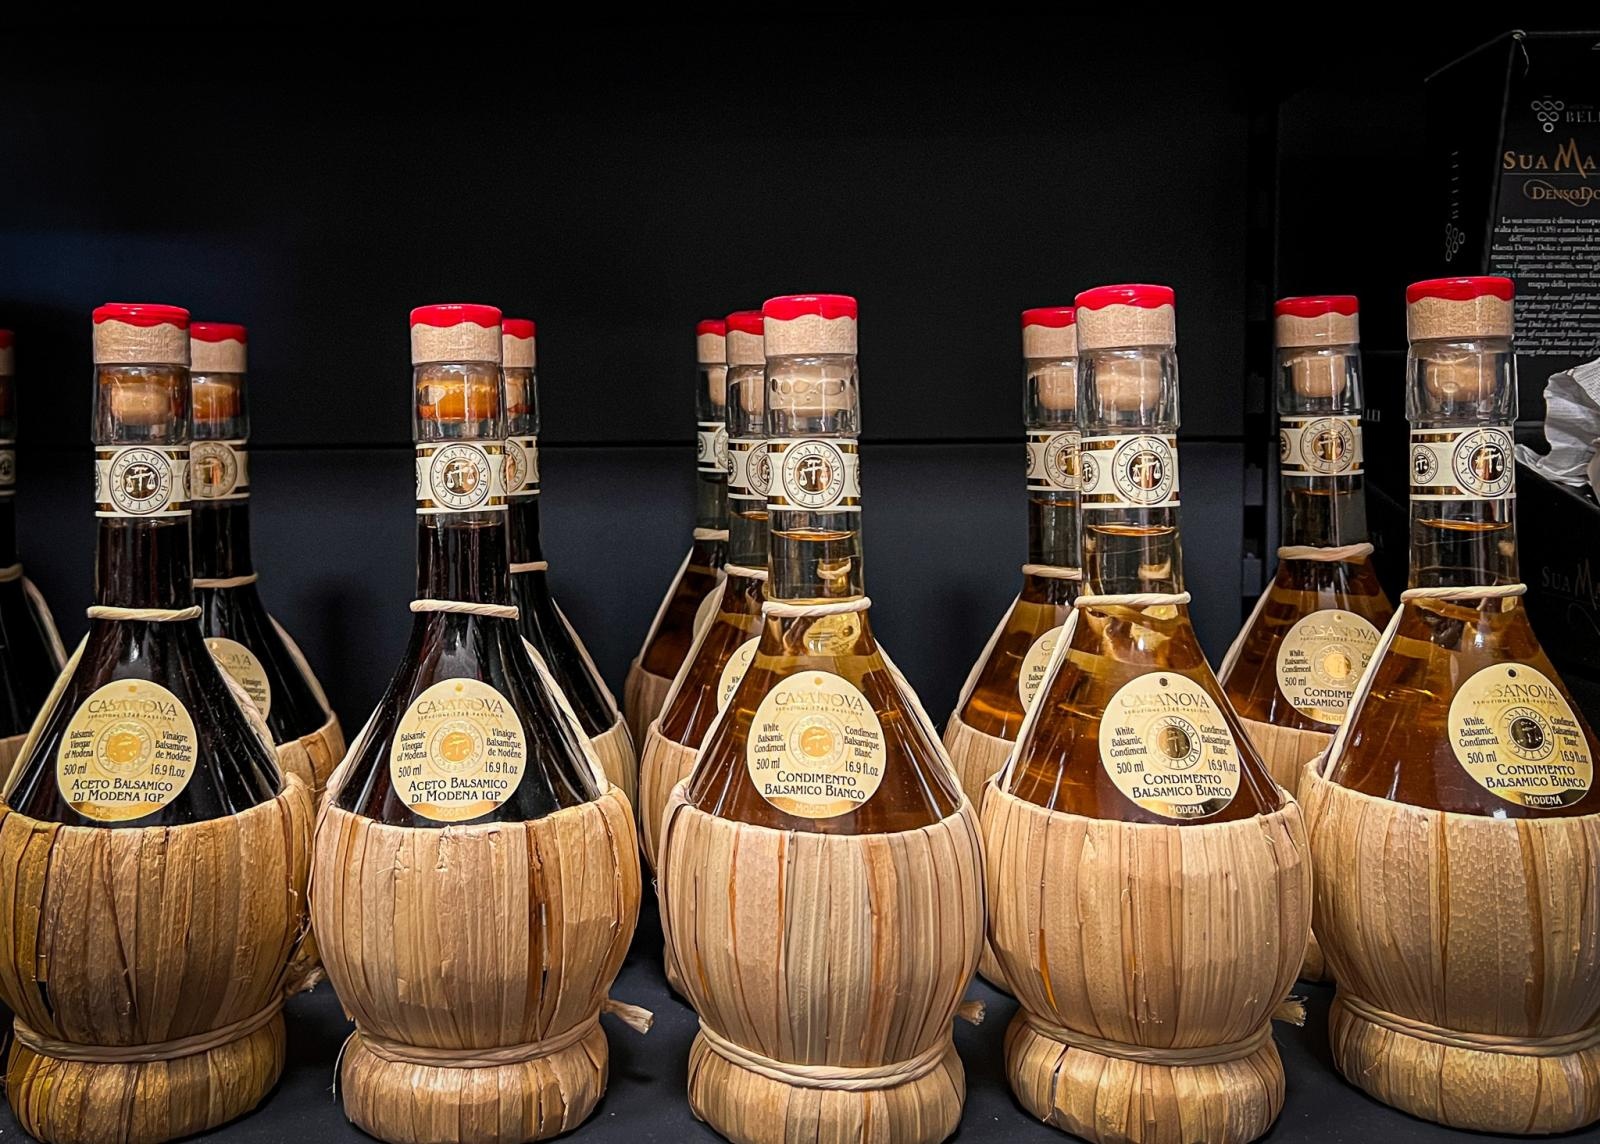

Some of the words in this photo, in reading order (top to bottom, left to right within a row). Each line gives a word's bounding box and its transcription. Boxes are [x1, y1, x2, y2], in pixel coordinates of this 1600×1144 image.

[1285, 677, 1296, 686] 500
[1298, 677, 1306, 685] ml
[1491, 684, 1557, 700] SANOVA
[417, 699, 504, 714] CASANOVA
[775, 692, 864, 711] CASANOVA
[1294, 697, 1344, 707] BALSAMICO
[88, 699, 177, 717] CASANOVA
[1464, 717, 1484, 726] White
[763, 723, 779, 732] White
[845, 726, 878, 739] Condiment
[1115, 727, 1134, 736] White
[1460, 727, 1493, 736] Balsamic
[70, 729, 95, 739] Balsamic
[162, 731, 188, 743] Vinaigre
[401, 731, 426, 741] Balsamic
[492, 728, 516, 740] Vinaigre
[758, 734, 784, 742] Balsamic
[70, 740, 91, 751] Vinegar
[402, 742, 423, 752] Vinegar
[486, 738, 521, 751] Balsamique
[844, 737, 879, 751] Balsamique
[1112, 737, 1142, 746] Balsamic
[1459, 737, 1499, 747] Condiment
[155, 740, 192, 755] Balsamique
[754, 743, 786, 753] Condiment
[854, 747, 872, 758] Blanc
[1110, 747, 1147, 757] Condiment
[72, 749, 93, 758] Modena
[156, 750, 165, 759] de
[404, 751, 427, 759] Modena
[1468, 753, 1484, 764] 500
[1487, 751, 1497, 762] ml
[64, 763, 76, 775] 500
[78, 763, 87, 774] ml
[150, 763, 167, 776] 16.9
[485, 762, 500, 772] 16.9
[756, 759, 770, 770] 500
[771, 758, 780, 768] ml
[845, 761, 860, 773] 16.9
[1117, 763, 1132, 774] 500
[1134, 761, 1144, 772] ml
[1208, 760, 1222, 771] 16.9
[1497, 764, 1575, 775] CONDIMENTO
[398, 766, 411, 778] 500
[412, 765, 421, 775] ml
[777, 771, 856, 786] CONDIMENTO
[1143, 774, 1221, 785] CONDIMENTO
[1486, 776, 1548, 788] BALSAMICO
[1551, 775, 1585, 787] BIANCO
[72, 779, 109, 790] ACETO
[114, 778, 173, 791] BALSAMICO
[409, 780, 446, 792] ACETO
[451, 778, 508, 789] BALSAMICO
[73, 792, 83, 802] DI
[88, 790, 140, 801] MODENA
[144, 793, 165, 802] IGP
[412, 794, 422, 803] DI
[427, 791, 478, 801] MODENA
[482, 792, 501, 800] IGP
[764, 784, 822, 795] BALSAMICO
[825, 785, 865, 799] BIANCO
[1133, 787, 1193, 798] BALSAMICO
[1195, 785, 1232, 797] BIANCO
[1525, 795, 1562, 805] MODENA
[1168, 804, 1205, 814] MODENA
